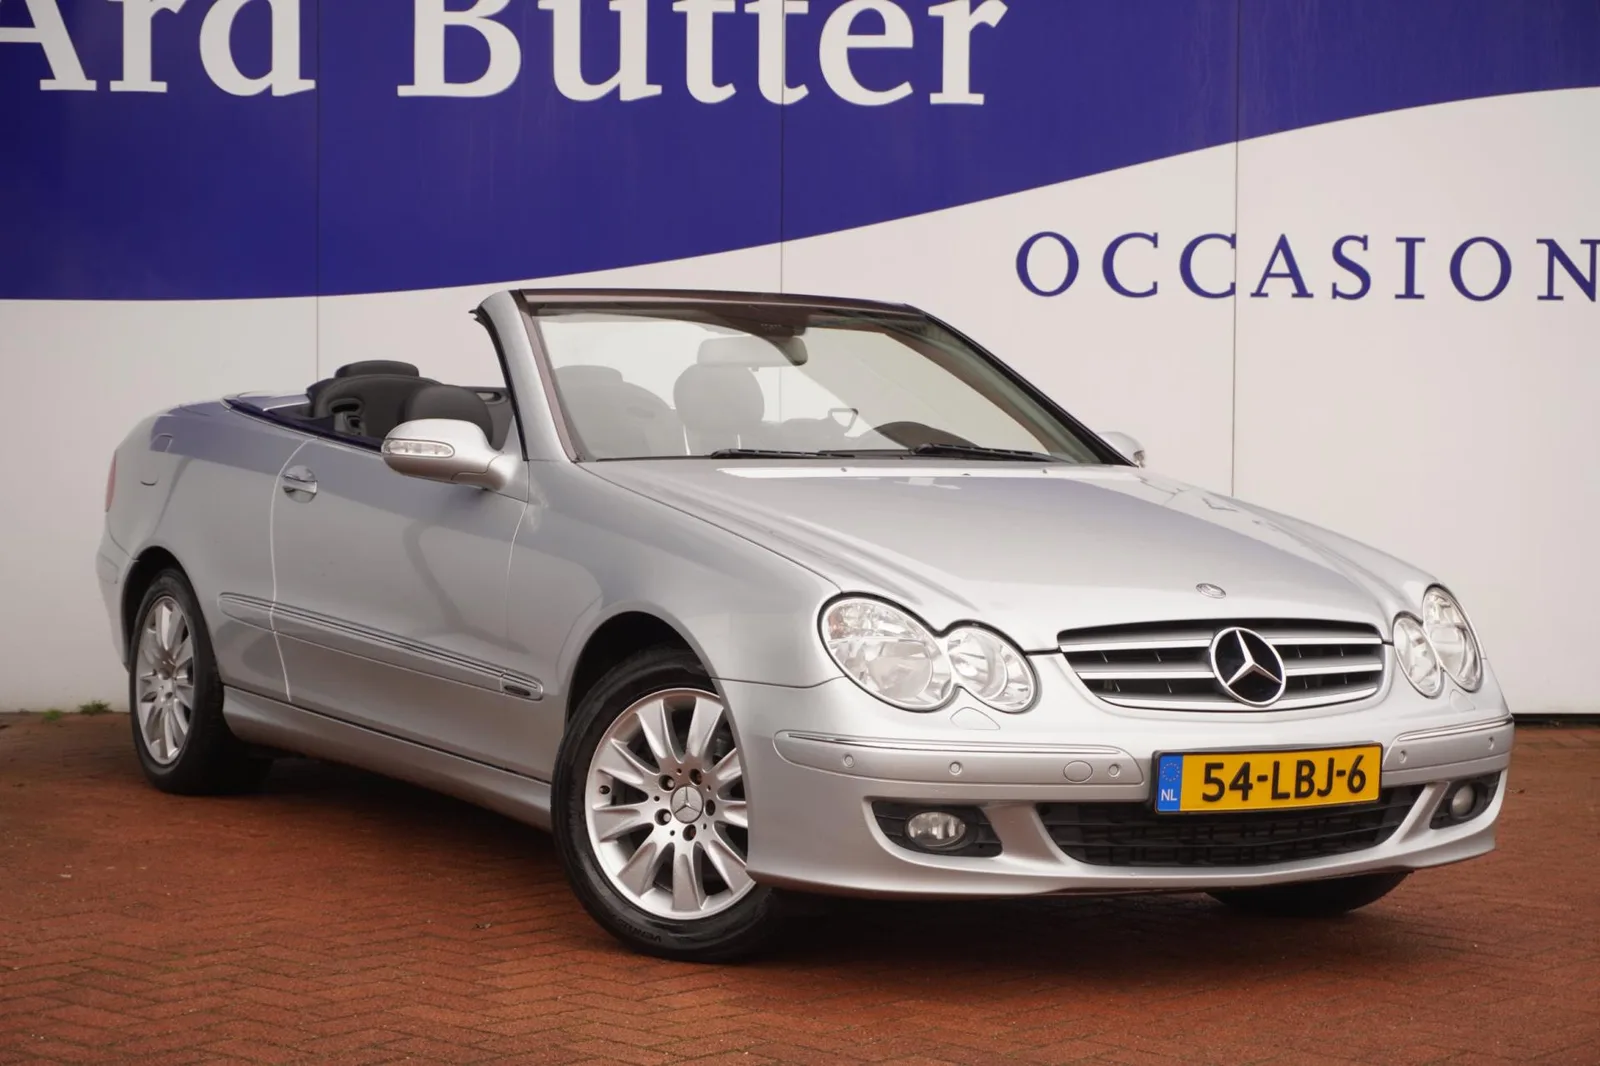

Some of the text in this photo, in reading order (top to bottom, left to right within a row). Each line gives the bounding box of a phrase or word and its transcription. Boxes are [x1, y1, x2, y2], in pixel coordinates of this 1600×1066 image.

[397, 0, 1008, 106] Butter
[1015, 231, 1600, 302] OCCASION
[1161, 754, 1366, 803] NL 54-LBJ-6
